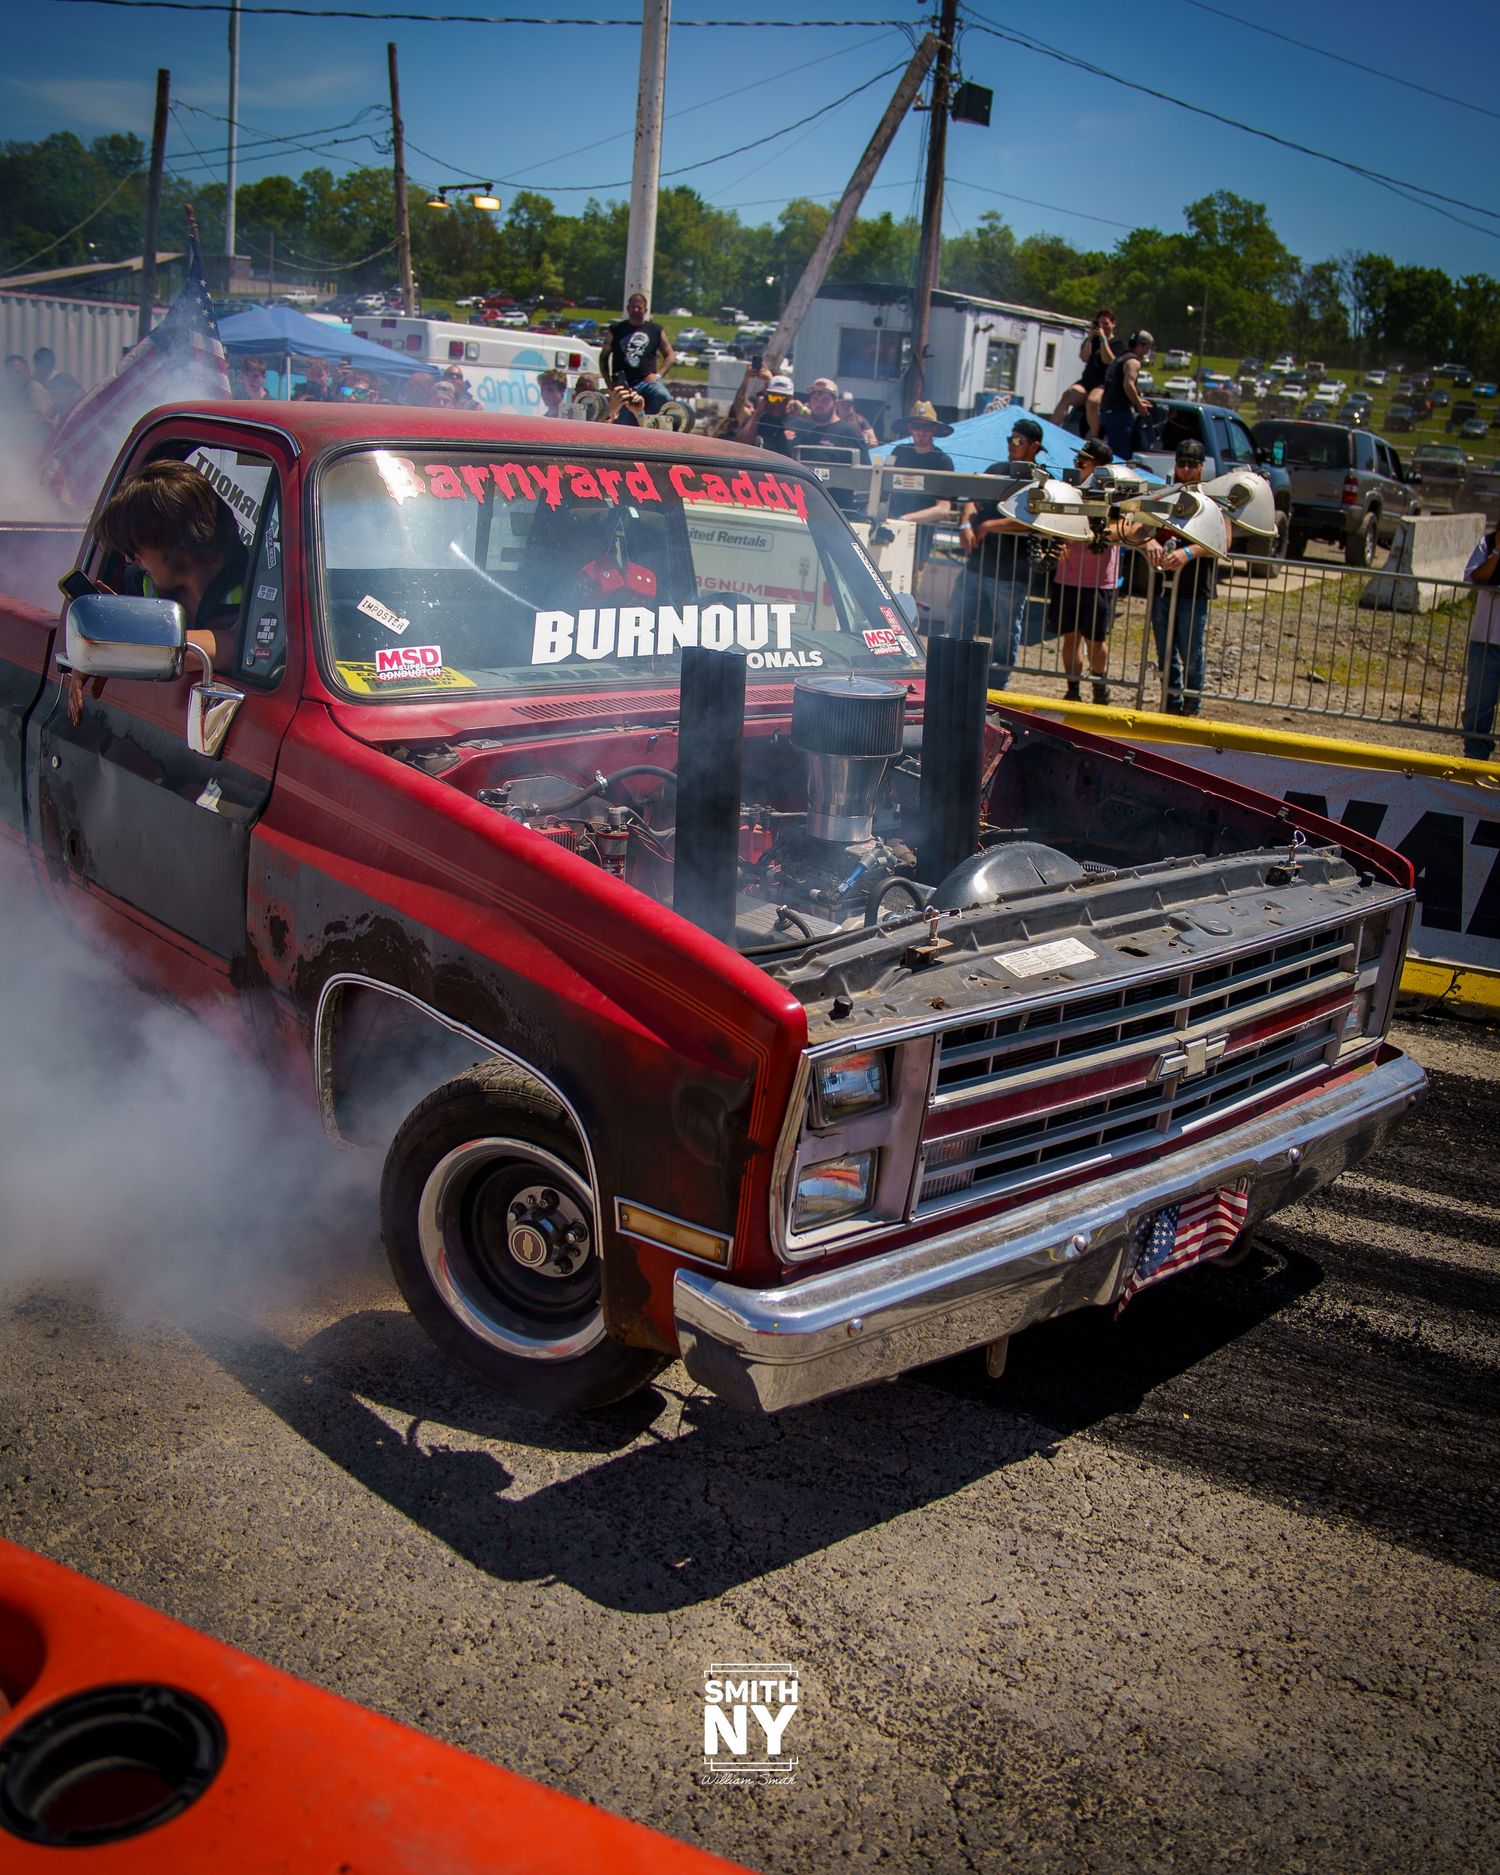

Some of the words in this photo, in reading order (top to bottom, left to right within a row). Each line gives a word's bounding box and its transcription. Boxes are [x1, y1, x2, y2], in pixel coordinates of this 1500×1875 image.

[377, 456, 663, 512] Barnyard
[669, 464, 808, 523] Caddy
[717, 531, 767, 547] Rentals
[361, 600, 405, 630] IMPOSTER
[531, 604, 796, 665] BURNOUT
[865, 632, 896, 648] MSD
[378, 648, 439, 671] MSD
[398, 662, 427, 671] SUPER
[746, 650, 824, 669] ONALS
[379, 667, 441, 681] CONDUCTOR
